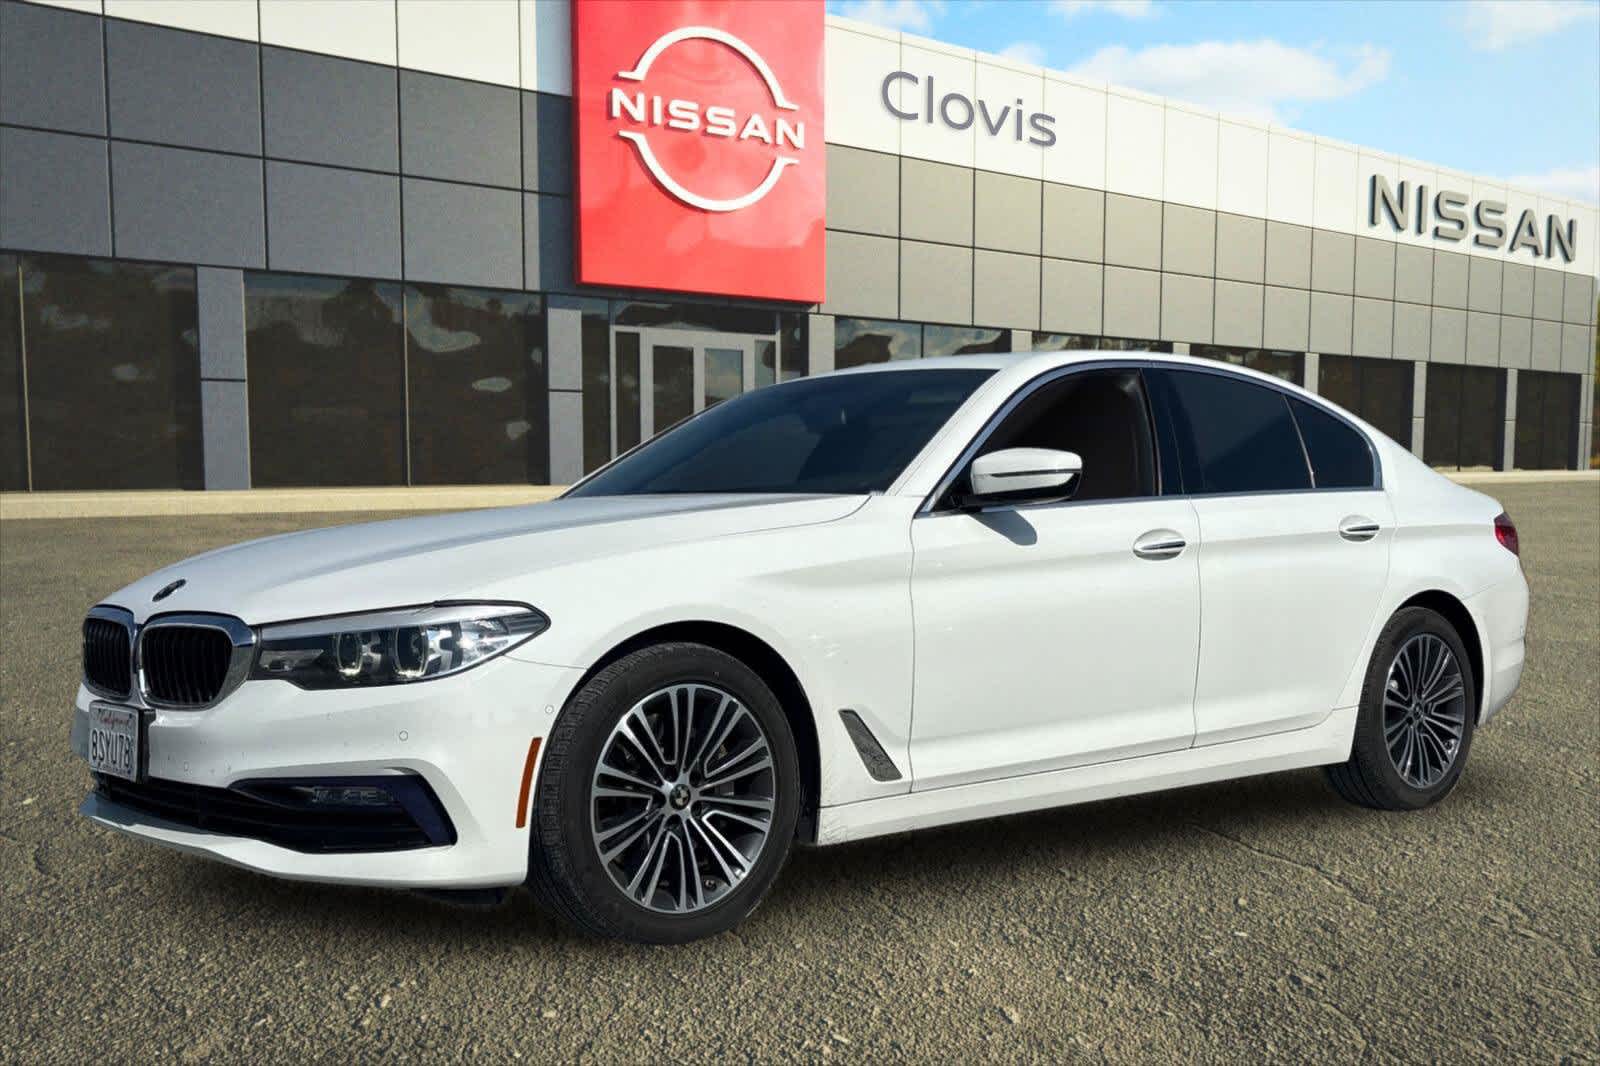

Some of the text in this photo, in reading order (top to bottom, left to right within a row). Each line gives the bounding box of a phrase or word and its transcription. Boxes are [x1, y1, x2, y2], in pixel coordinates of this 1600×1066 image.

[610, 87, 805, 149] NISSAN
[882, 71, 1057, 147] Clovis
[1369, 174, 1577, 263] NISSAN
